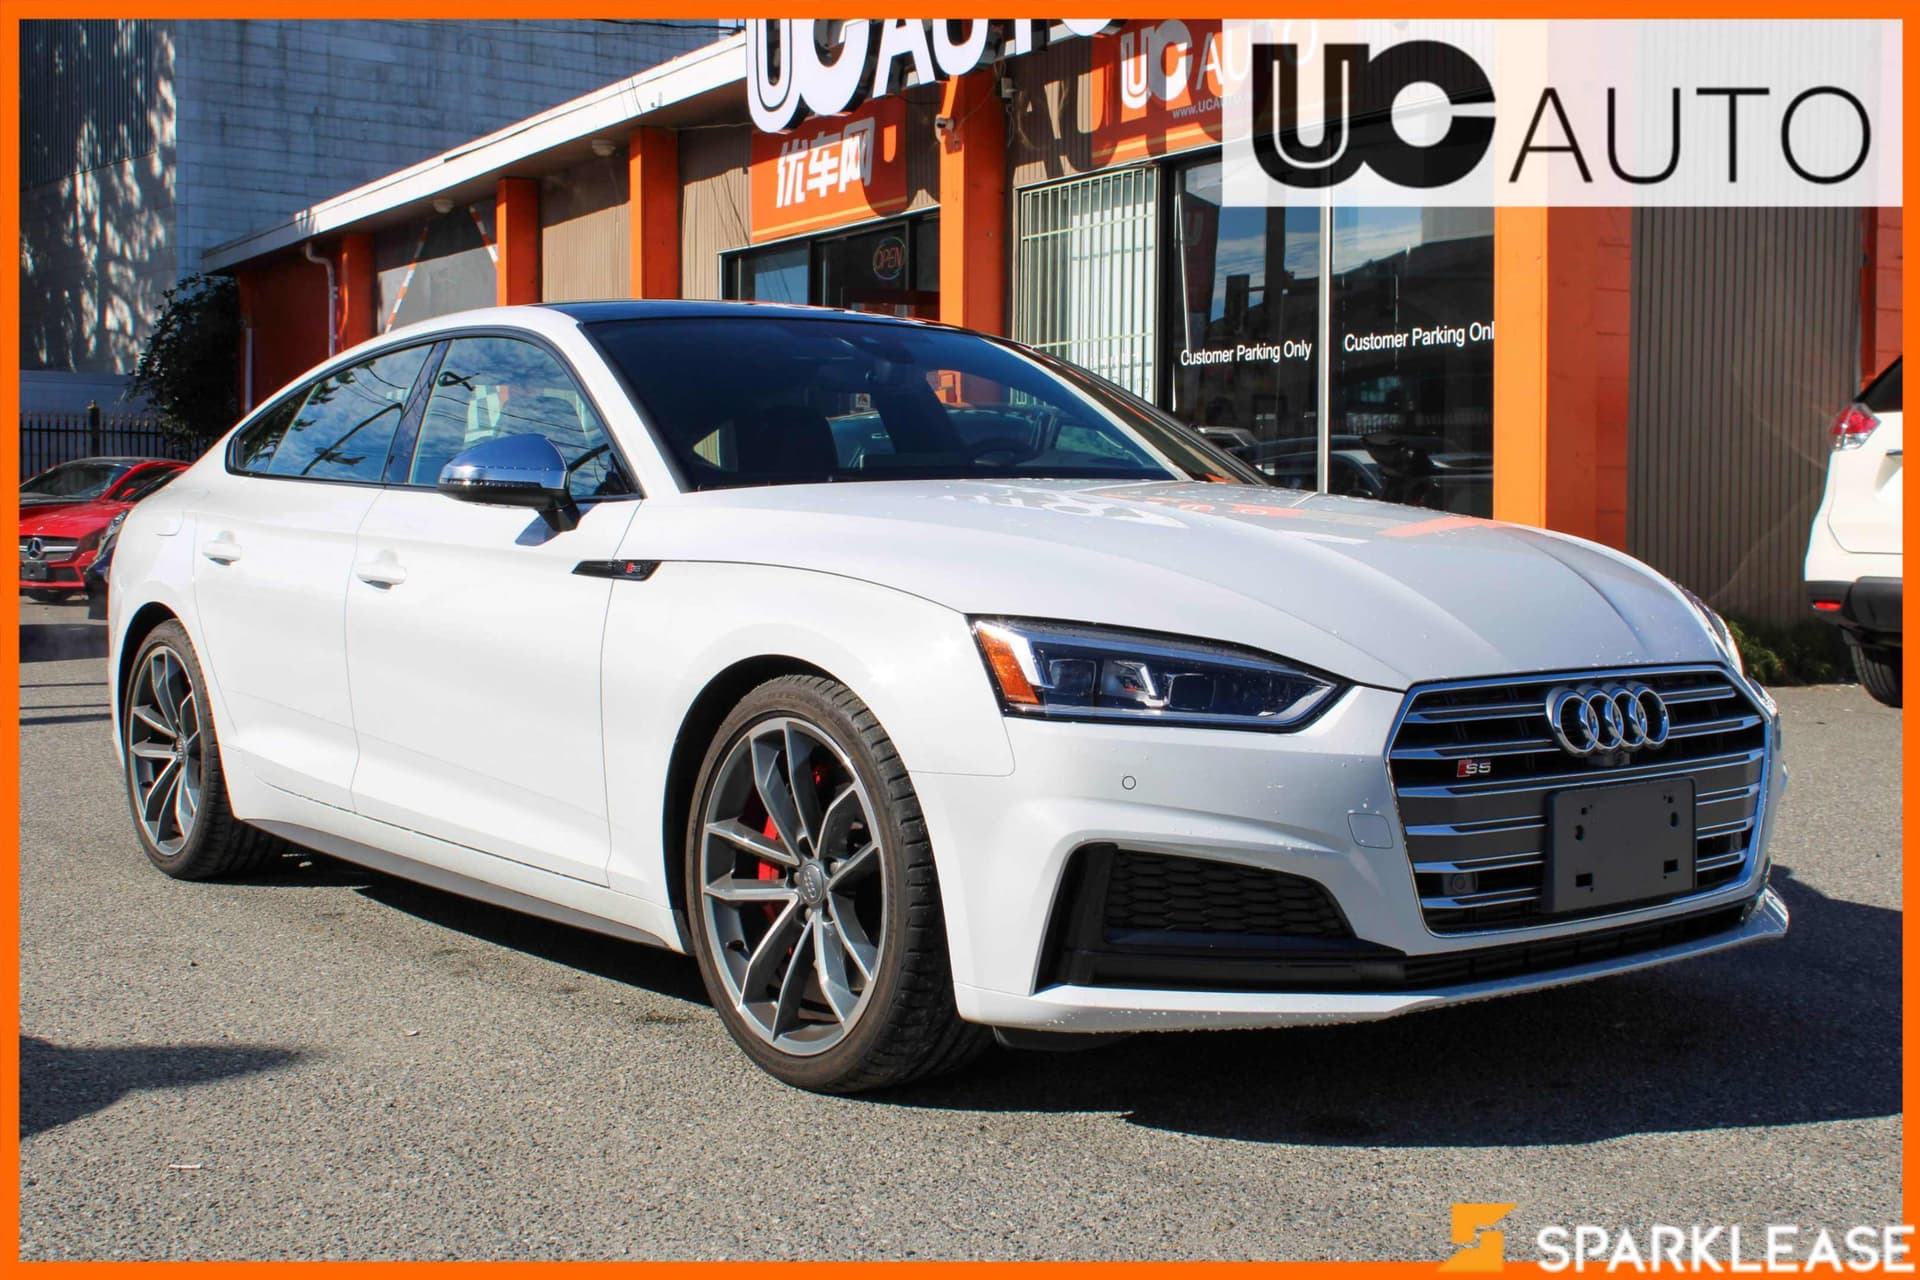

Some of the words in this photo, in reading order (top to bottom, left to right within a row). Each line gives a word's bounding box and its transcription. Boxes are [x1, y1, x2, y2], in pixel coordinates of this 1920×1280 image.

[776, 116, 875, 208] 优车网
[874, 247, 905, 270] OPEN
[1344, 331, 1408, 352] Customer
[1411, 325, 1465, 347] Parking
[1469, 321, 1494, 341] Onl
[1180, 347, 1234, 366] Customer
[1236, 343, 1280, 362] Parking
[1283, 340, 1312, 361] Only
[1463, 762, 1492, 775] S5
